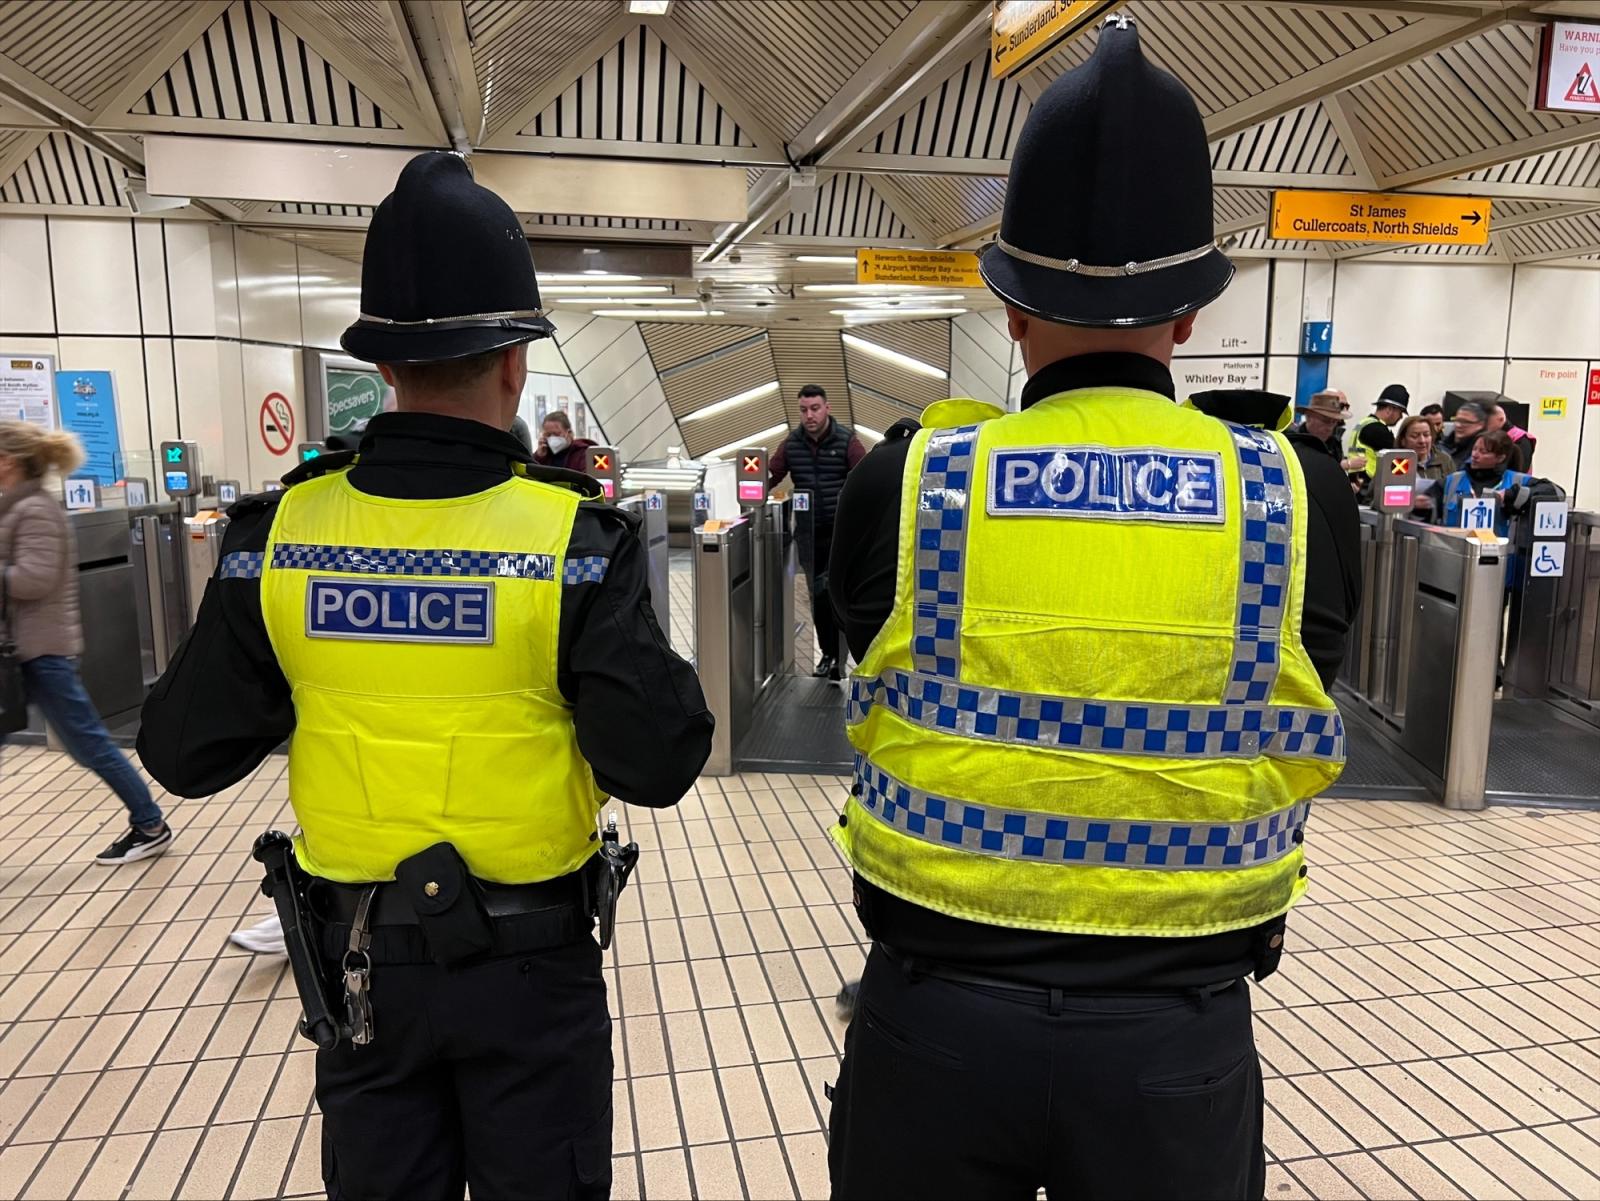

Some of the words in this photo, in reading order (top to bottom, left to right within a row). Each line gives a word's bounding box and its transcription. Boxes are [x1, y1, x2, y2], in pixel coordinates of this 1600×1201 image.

[1008, 0, 1059, 51] Sunderland,
[1559, 43, 1579, 53] Have
[1580, 46, 1594, 55] you
[1350, 204, 1363, 216] St
[1367, 205, 1406, 218] James
[1293, 219, 1370, 234] Cullercoats,
[1373, 222, 1409, 234] North
[1412, 223, 1458, 236] Shields
[1222, 338, 1239, 348] Lift
[1185, 374, 1224, 385] Whitley
[1227, 374, 1247, 384] Bay
[1540, 370, 1556, 378] Fire
[1557, 370, 1578, 379] point
[328, 390, 375, 417] Specsavers
[1543, 399, 1563, 408] LIFT
[1004, 459, 1214, 509] POLICE
[317, 587, 483, 632] POLICE
